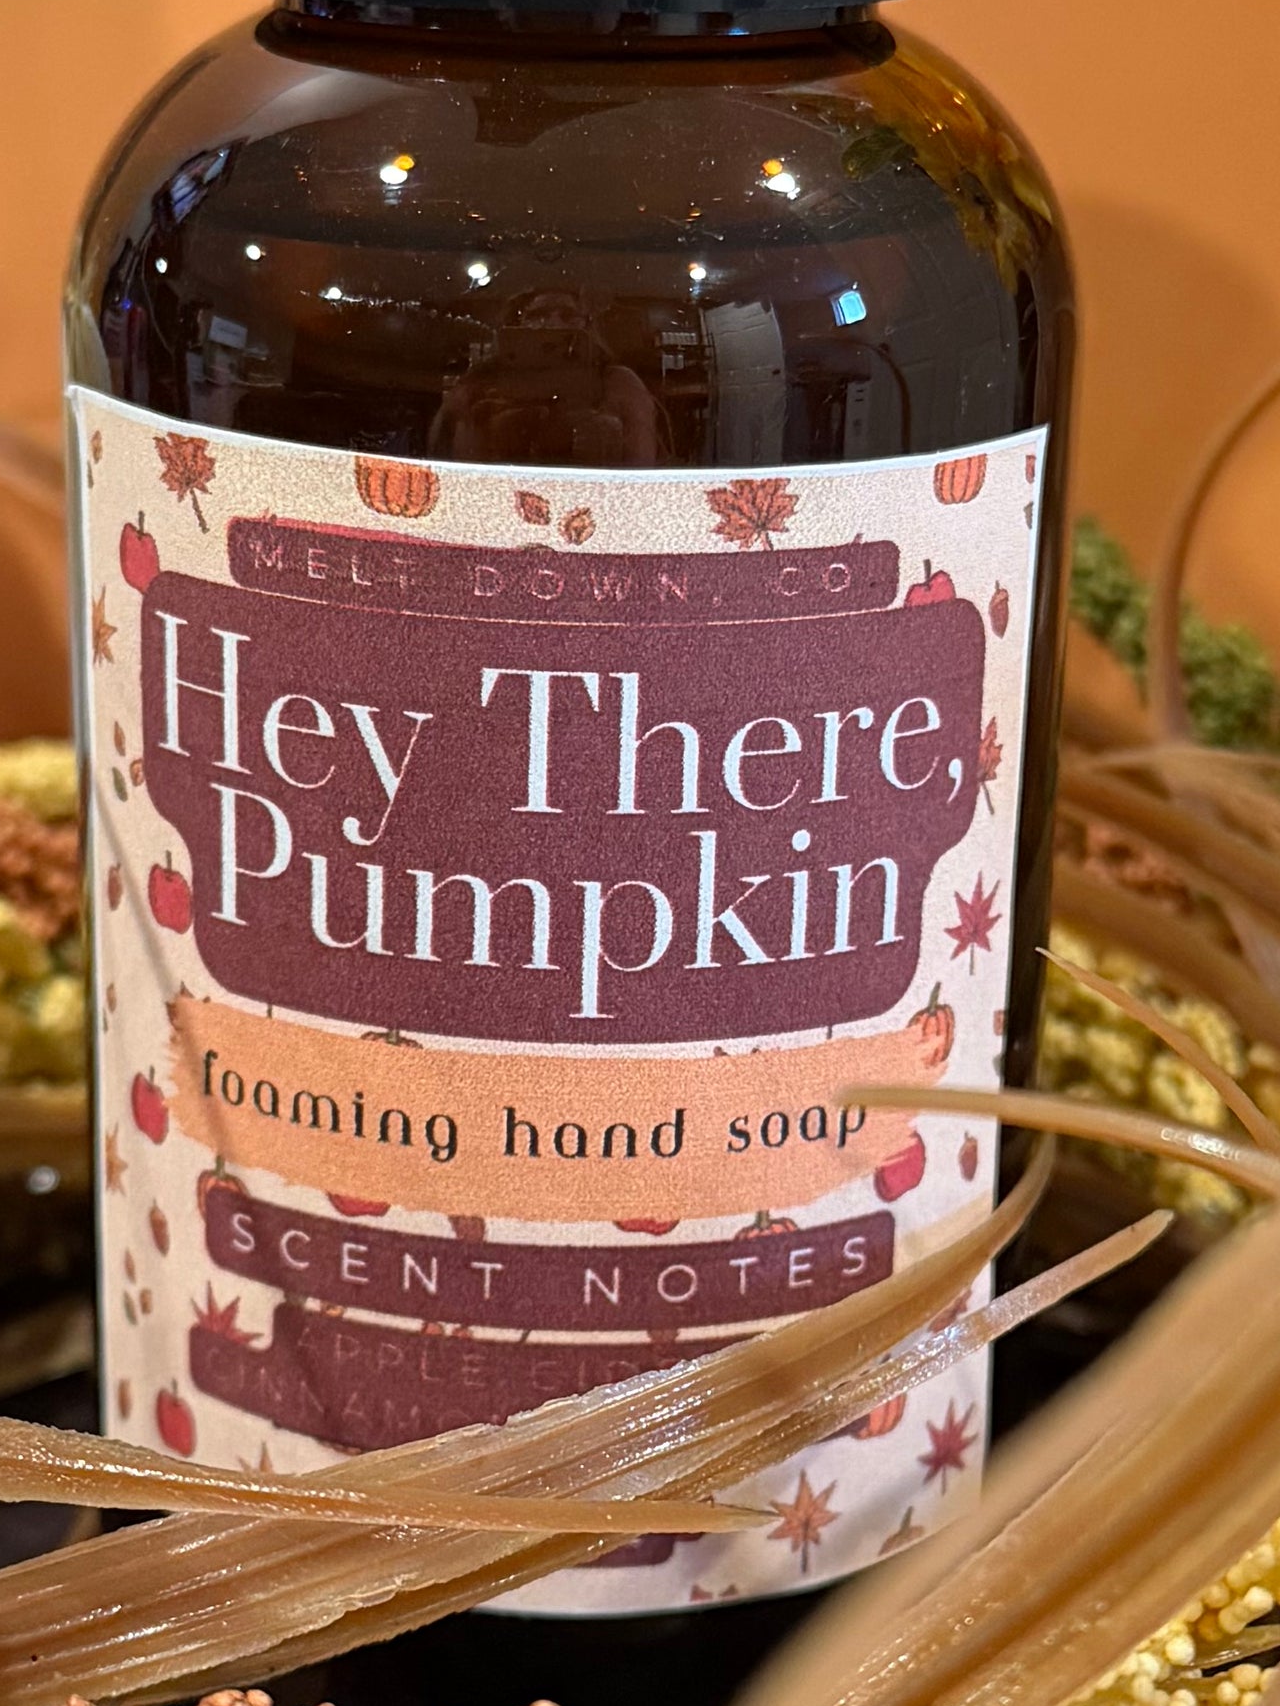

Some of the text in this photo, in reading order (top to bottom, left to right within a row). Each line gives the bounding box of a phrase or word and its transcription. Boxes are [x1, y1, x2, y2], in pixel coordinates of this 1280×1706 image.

[154, 609, 964, 847] Hey There,
[208, 782, 906, 1020] Pumpkin
[201, 1049, 868, 1163] foaming hand soap
[229, 1212, 868, 1306] SCENT NOTES
[297, 1324, 487, 1388] APPLE
